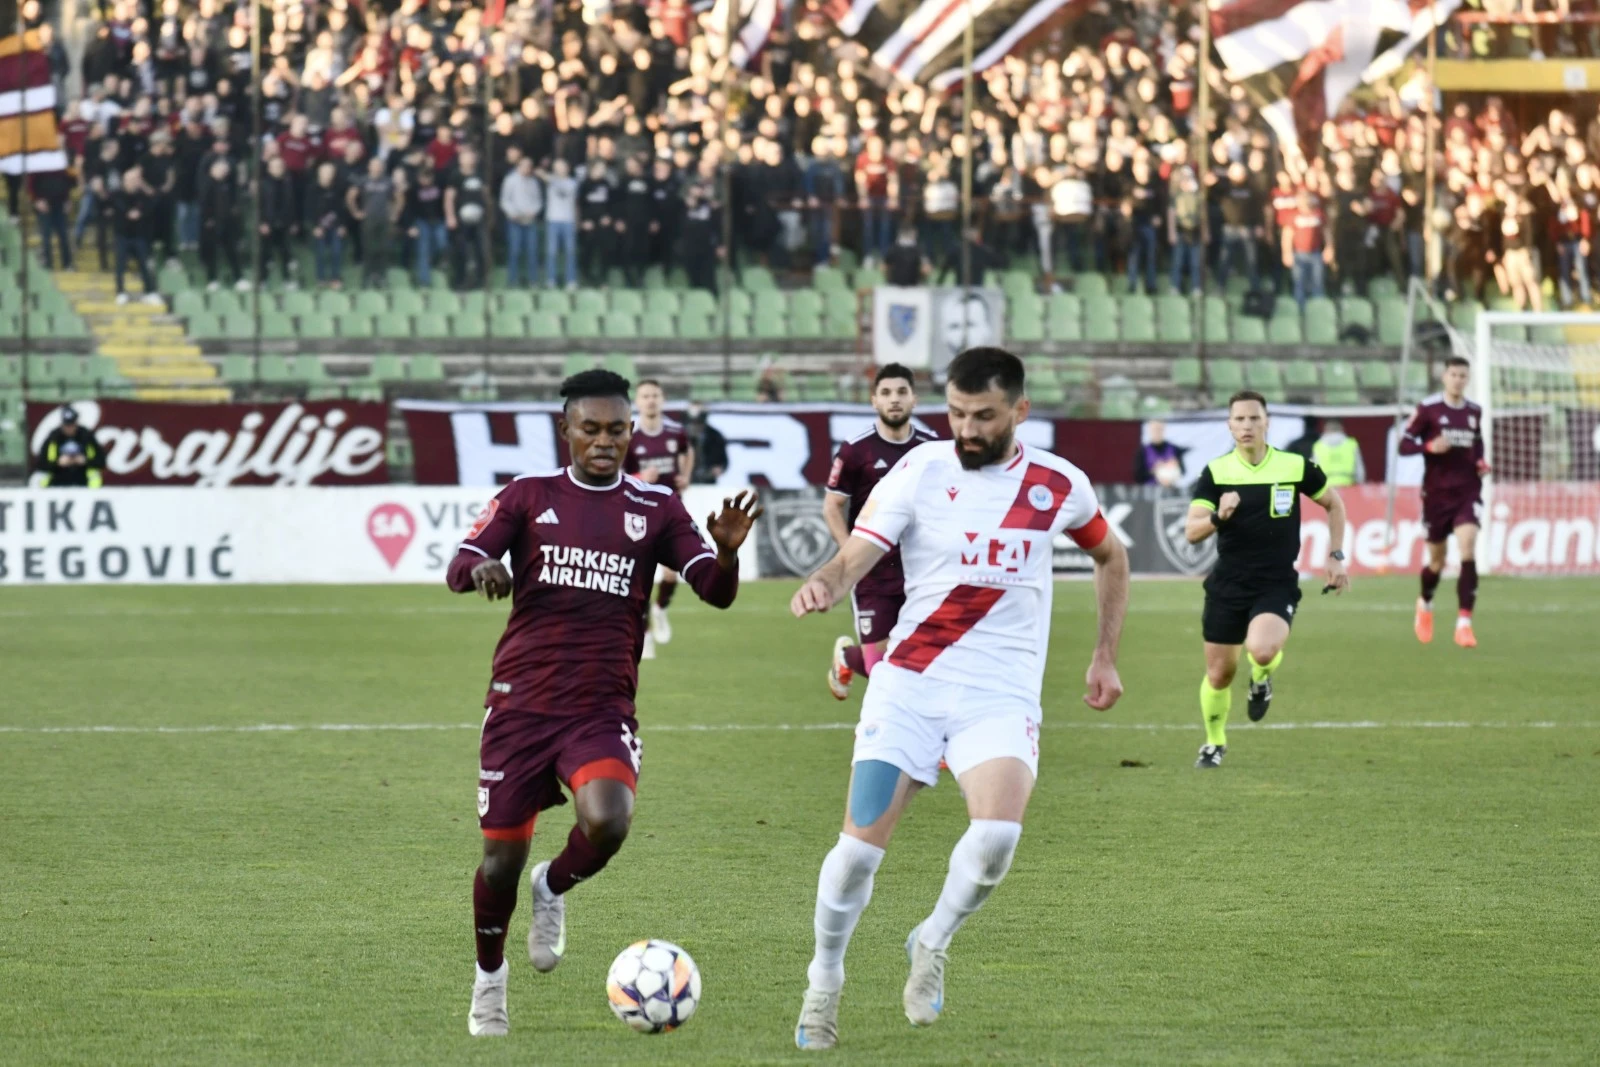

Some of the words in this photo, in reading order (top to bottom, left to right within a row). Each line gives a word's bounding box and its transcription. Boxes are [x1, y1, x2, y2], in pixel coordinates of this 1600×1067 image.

[373, 513, 411, 538] SA
[540, 545, 635, 577] TURKISH
[538, 564, 631, 597] AIRLINES
